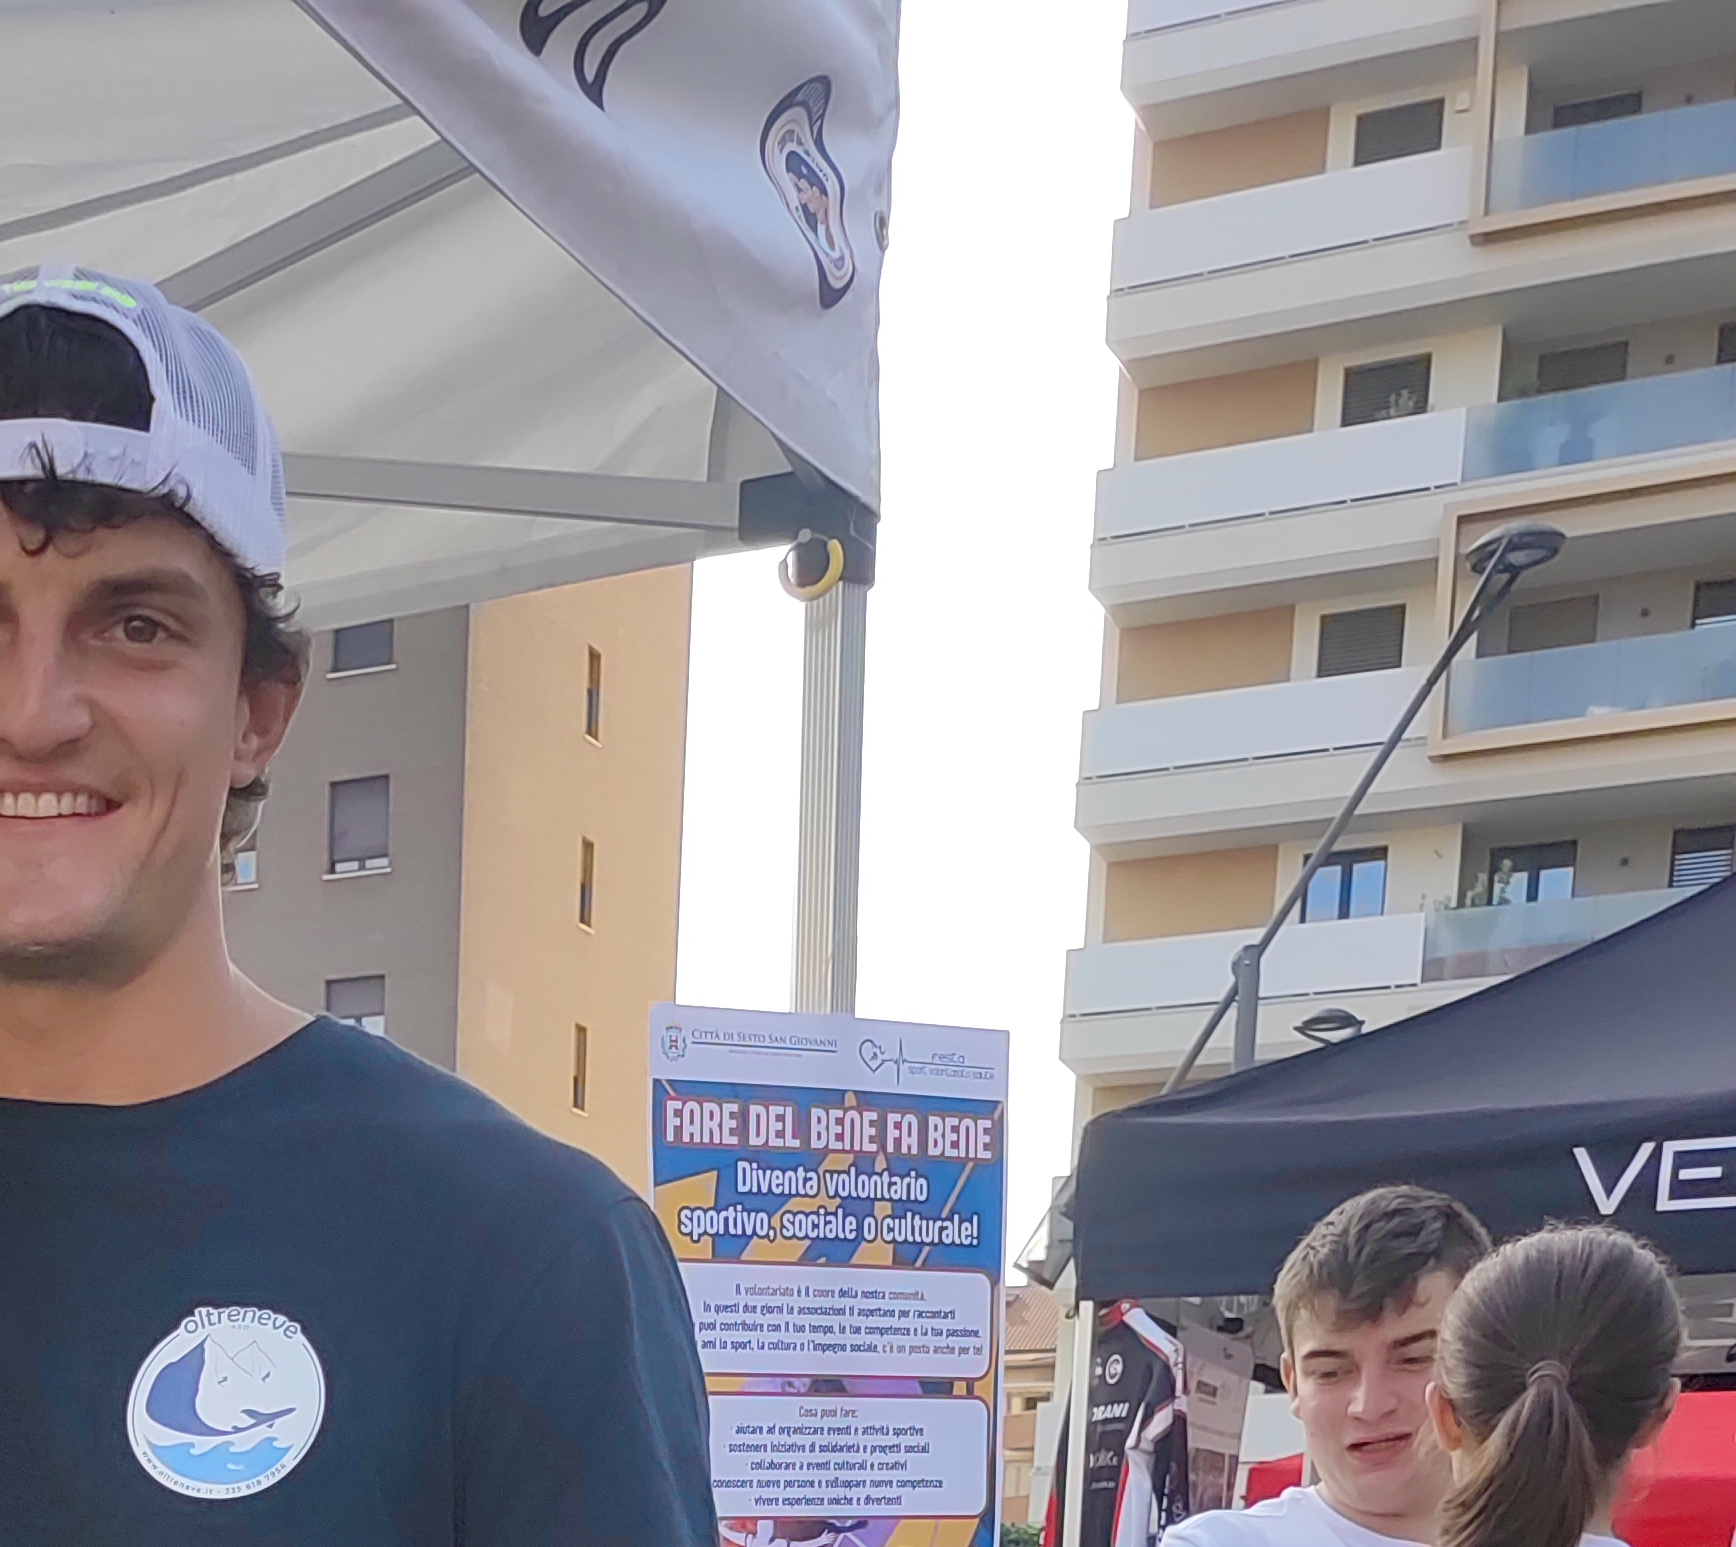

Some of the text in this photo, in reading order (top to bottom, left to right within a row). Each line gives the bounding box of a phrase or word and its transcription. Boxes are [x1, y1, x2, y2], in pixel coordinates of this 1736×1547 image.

[666, 1101, 993, 1160] FARE DEL BENE FA BENE
[737, 1161, 928, 1201] Diventa volontario
[679, 1205, 979, 1246] sportivo, sociale o culturale!
[838, 1287, 858, 1299] della
[861, 1289, 885, 1300] nostra
[714, 1301, 739, 1316] questi
[742, 1302, 757, 1314] due
[760, 1303, 783, 1316] giorni
[857, 1307, 895, 1319] aspettano
[898, 1309, 910, 1321] per
[184, 1308, 299, 1340] oltreneve
[698, 1320, 716, 1333] puoi
[719, 1320, 764, 1332] contribuire
[792, 1322, 806, 1333] tuo
[849, 1323, 861, 1335] tue
[931, 1325, 943, 1337] tua
[701, 1337, 716, 1349] ami
[767, 1339, 797, 1351] cultura
[798, 1405, 817, 1417] Cosa
[820, 1406, 837, 1420] puoi
[735, 1424, 763, 1435] aiutare
[766, 1423, 776, 1435] ad
[778, 1424, 824, 1437] organizzare
[827, 1424, 851, 1436] eventi
[892, 1425, 924, 1439] sportive
[750, 1459, 796, 1471] collaborare
[806, 1459, 831, 1471] eventi
[833, 1459, 867, 1471] culturali
[877, 1459, 907, 1471] creativi
[783, 1479, 815, 1491] persone
[754, 1495, 779, 1506] vivere
